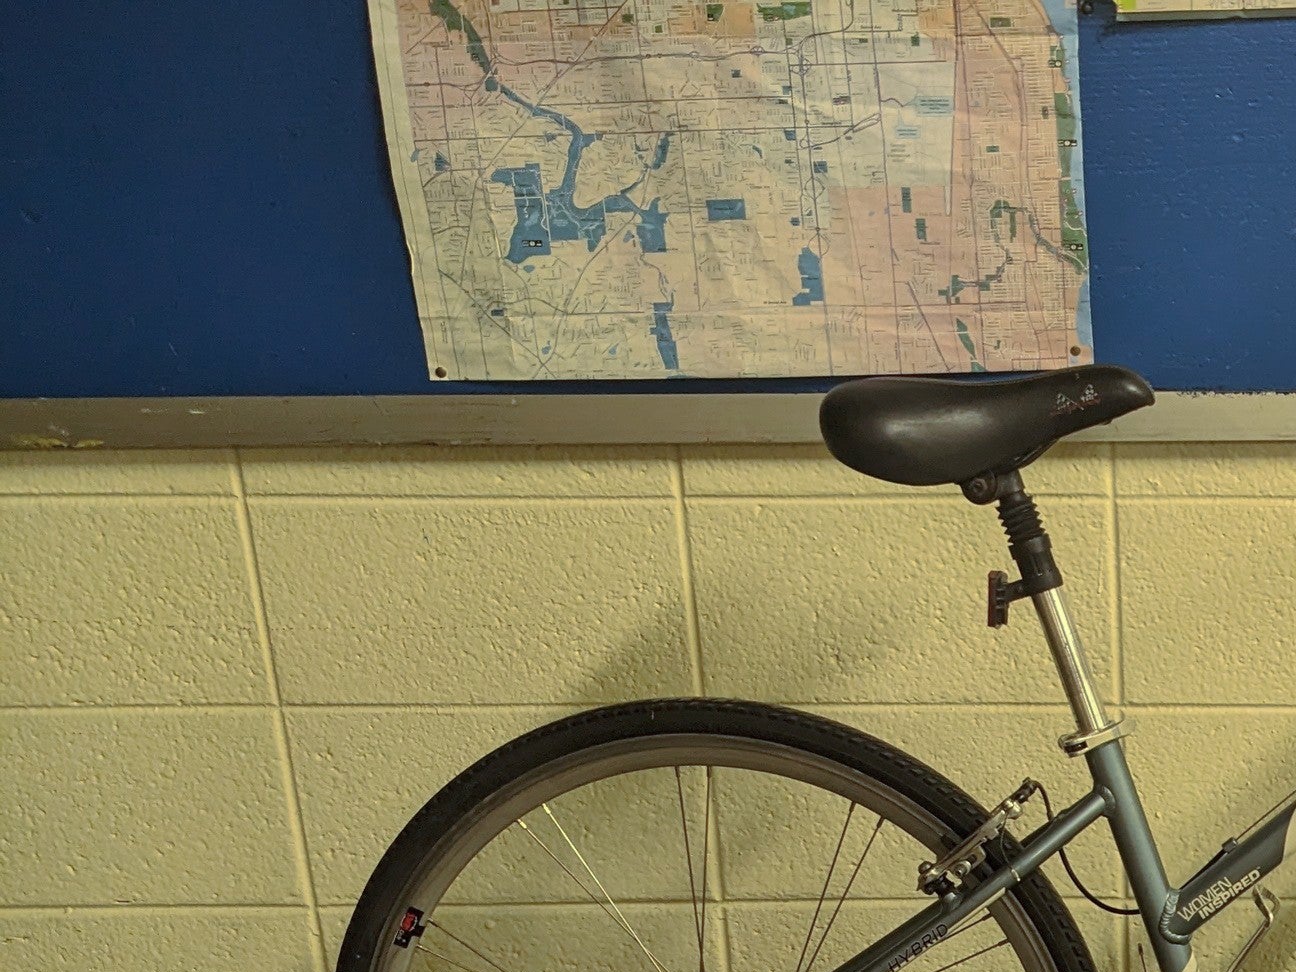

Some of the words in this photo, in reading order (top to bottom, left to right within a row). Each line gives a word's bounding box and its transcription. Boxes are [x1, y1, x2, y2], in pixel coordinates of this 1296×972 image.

[1177, 876, 1232, 922] WOMEN
[1199, 869, 1261, 919] INSPIRED
[888, 923, 949, 972] HYBRID
